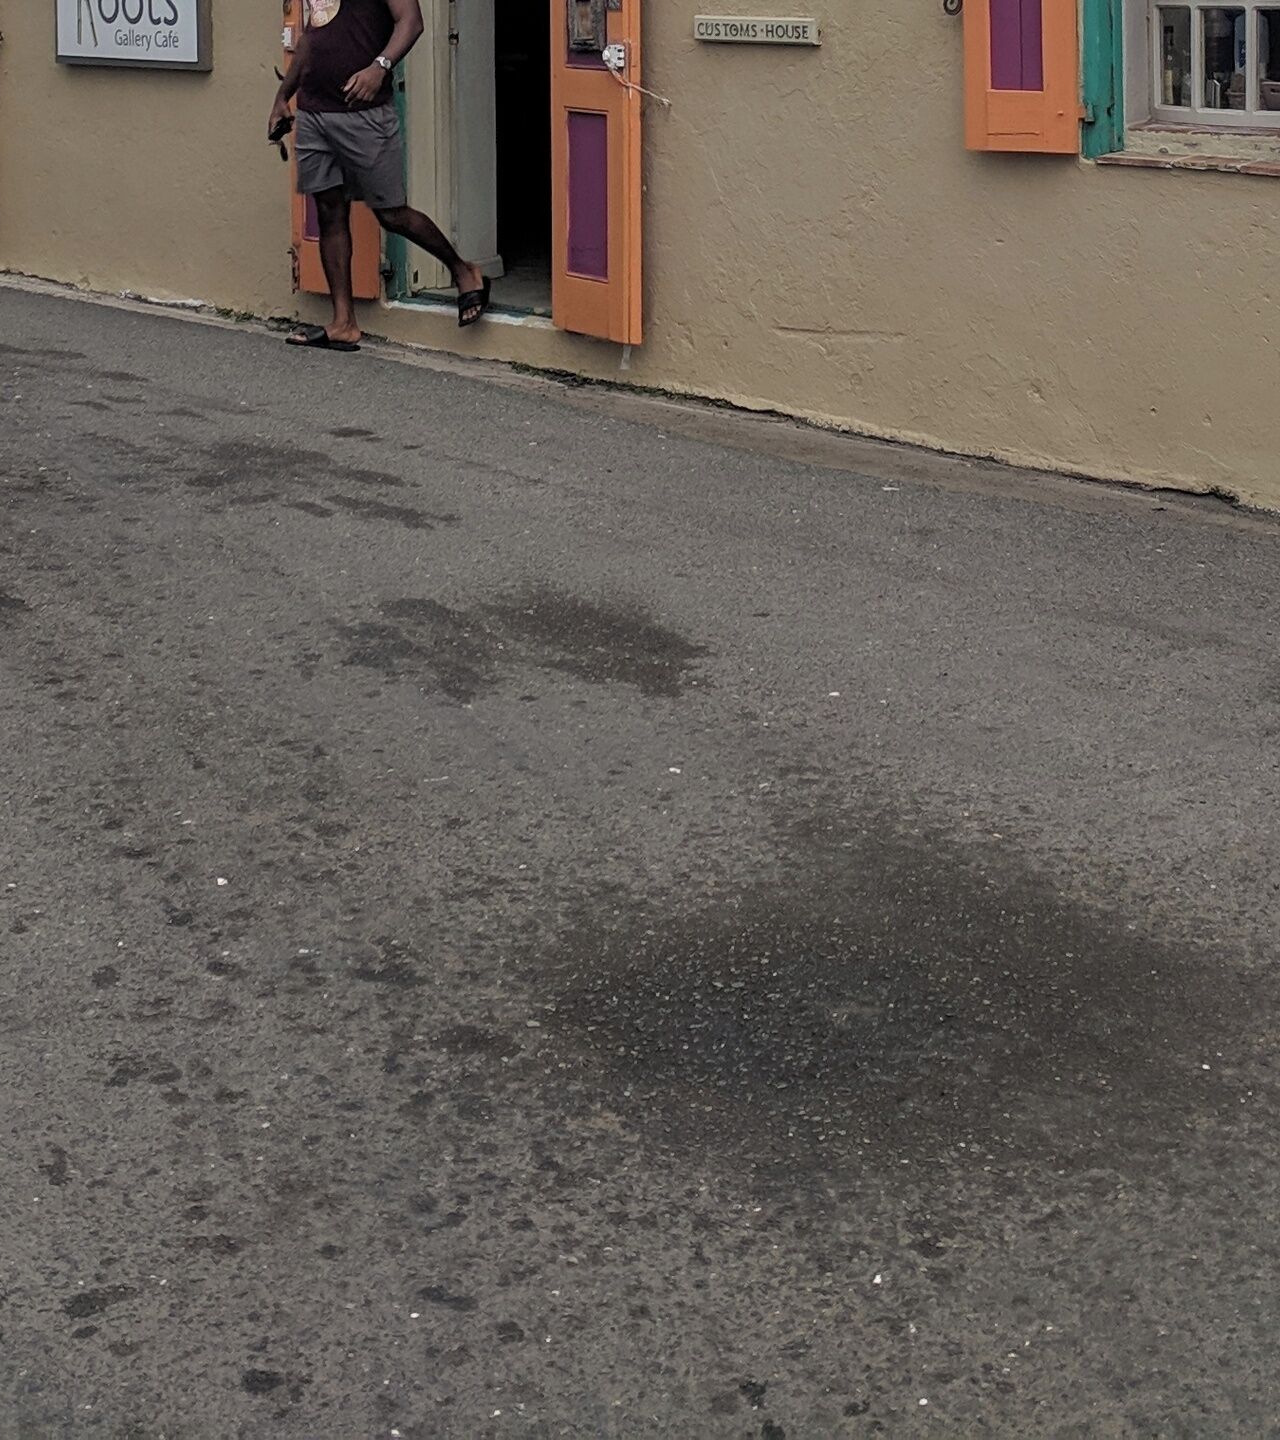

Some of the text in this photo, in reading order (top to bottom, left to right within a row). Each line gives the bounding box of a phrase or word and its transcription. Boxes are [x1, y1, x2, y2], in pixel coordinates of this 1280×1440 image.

[114, 29, 152, 52] Gallery
[696, 22, 810, 40] CUSTOMS HOUSE
